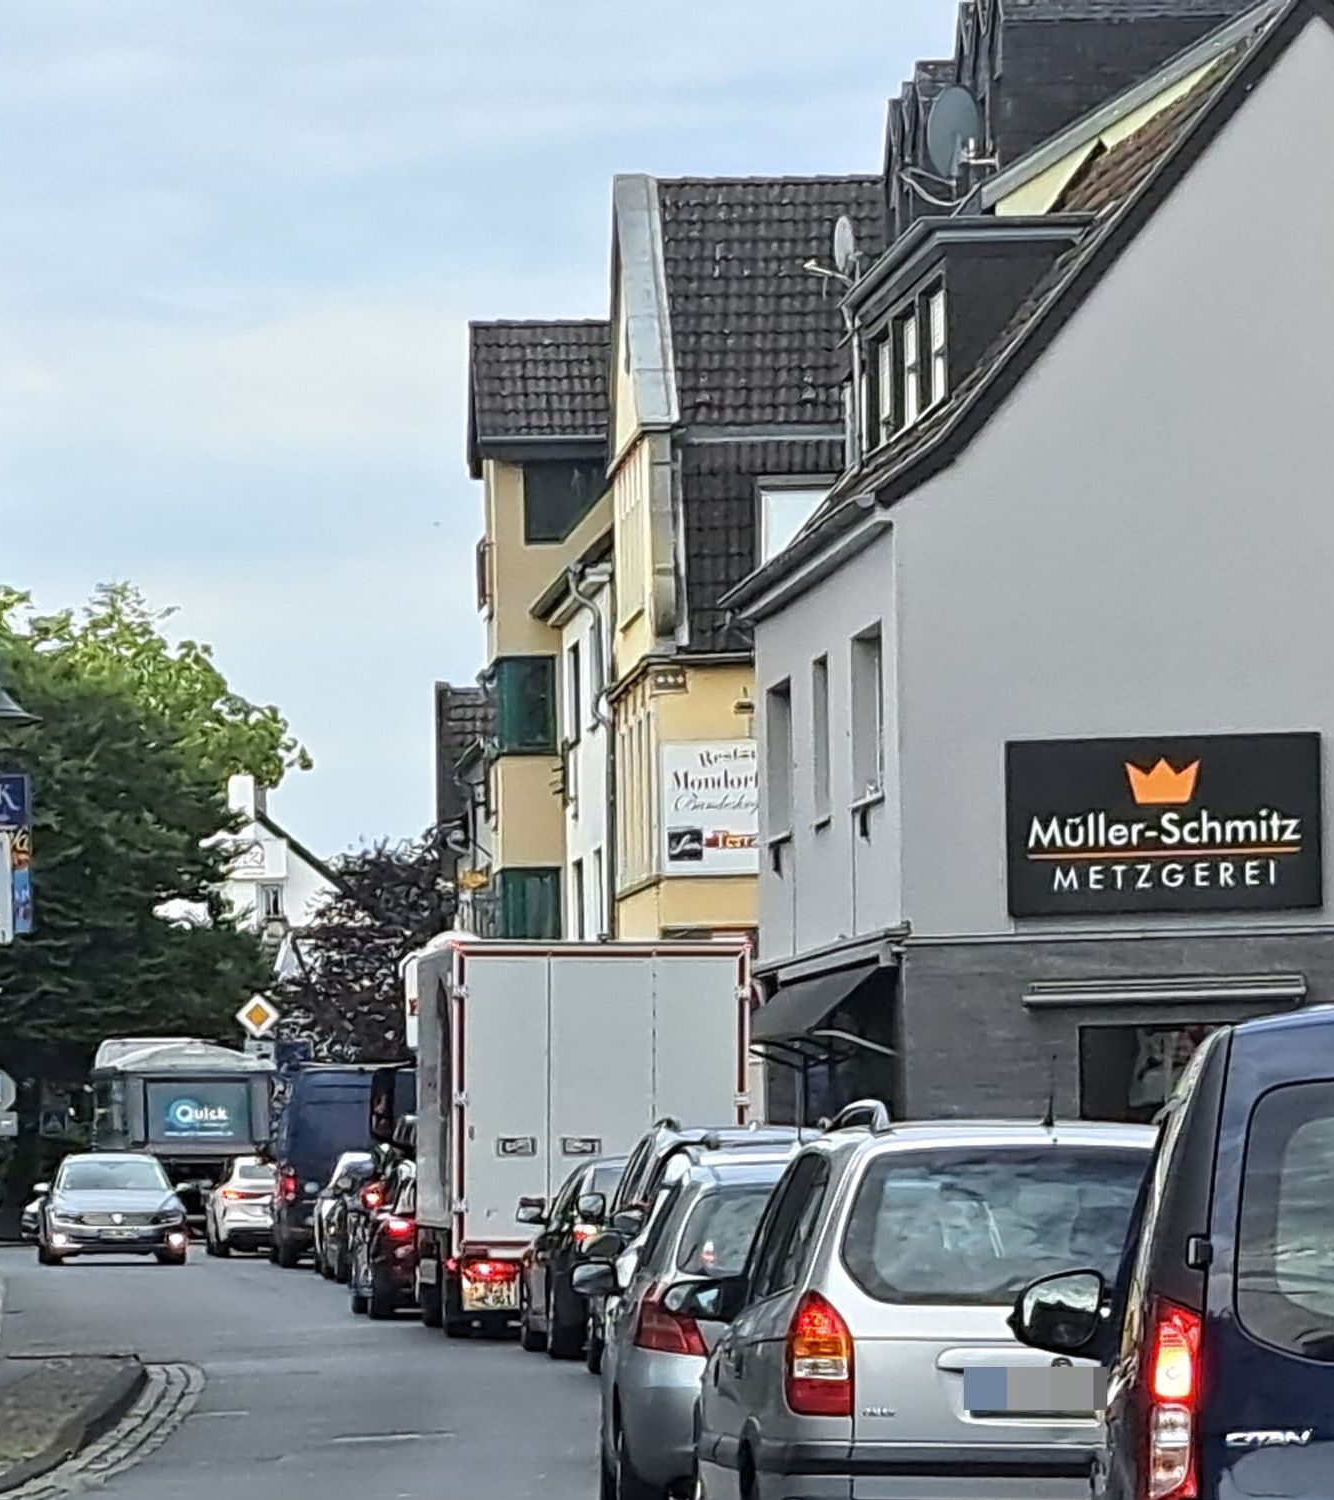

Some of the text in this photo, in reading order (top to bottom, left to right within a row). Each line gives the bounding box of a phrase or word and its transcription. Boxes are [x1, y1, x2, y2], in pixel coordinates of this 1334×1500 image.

[1028, 808, 1302, 849] Müller-Schmitz
[1053, 859, 1276, 892] METZGEREI
[175, 1104, 227, 1123] Quick
